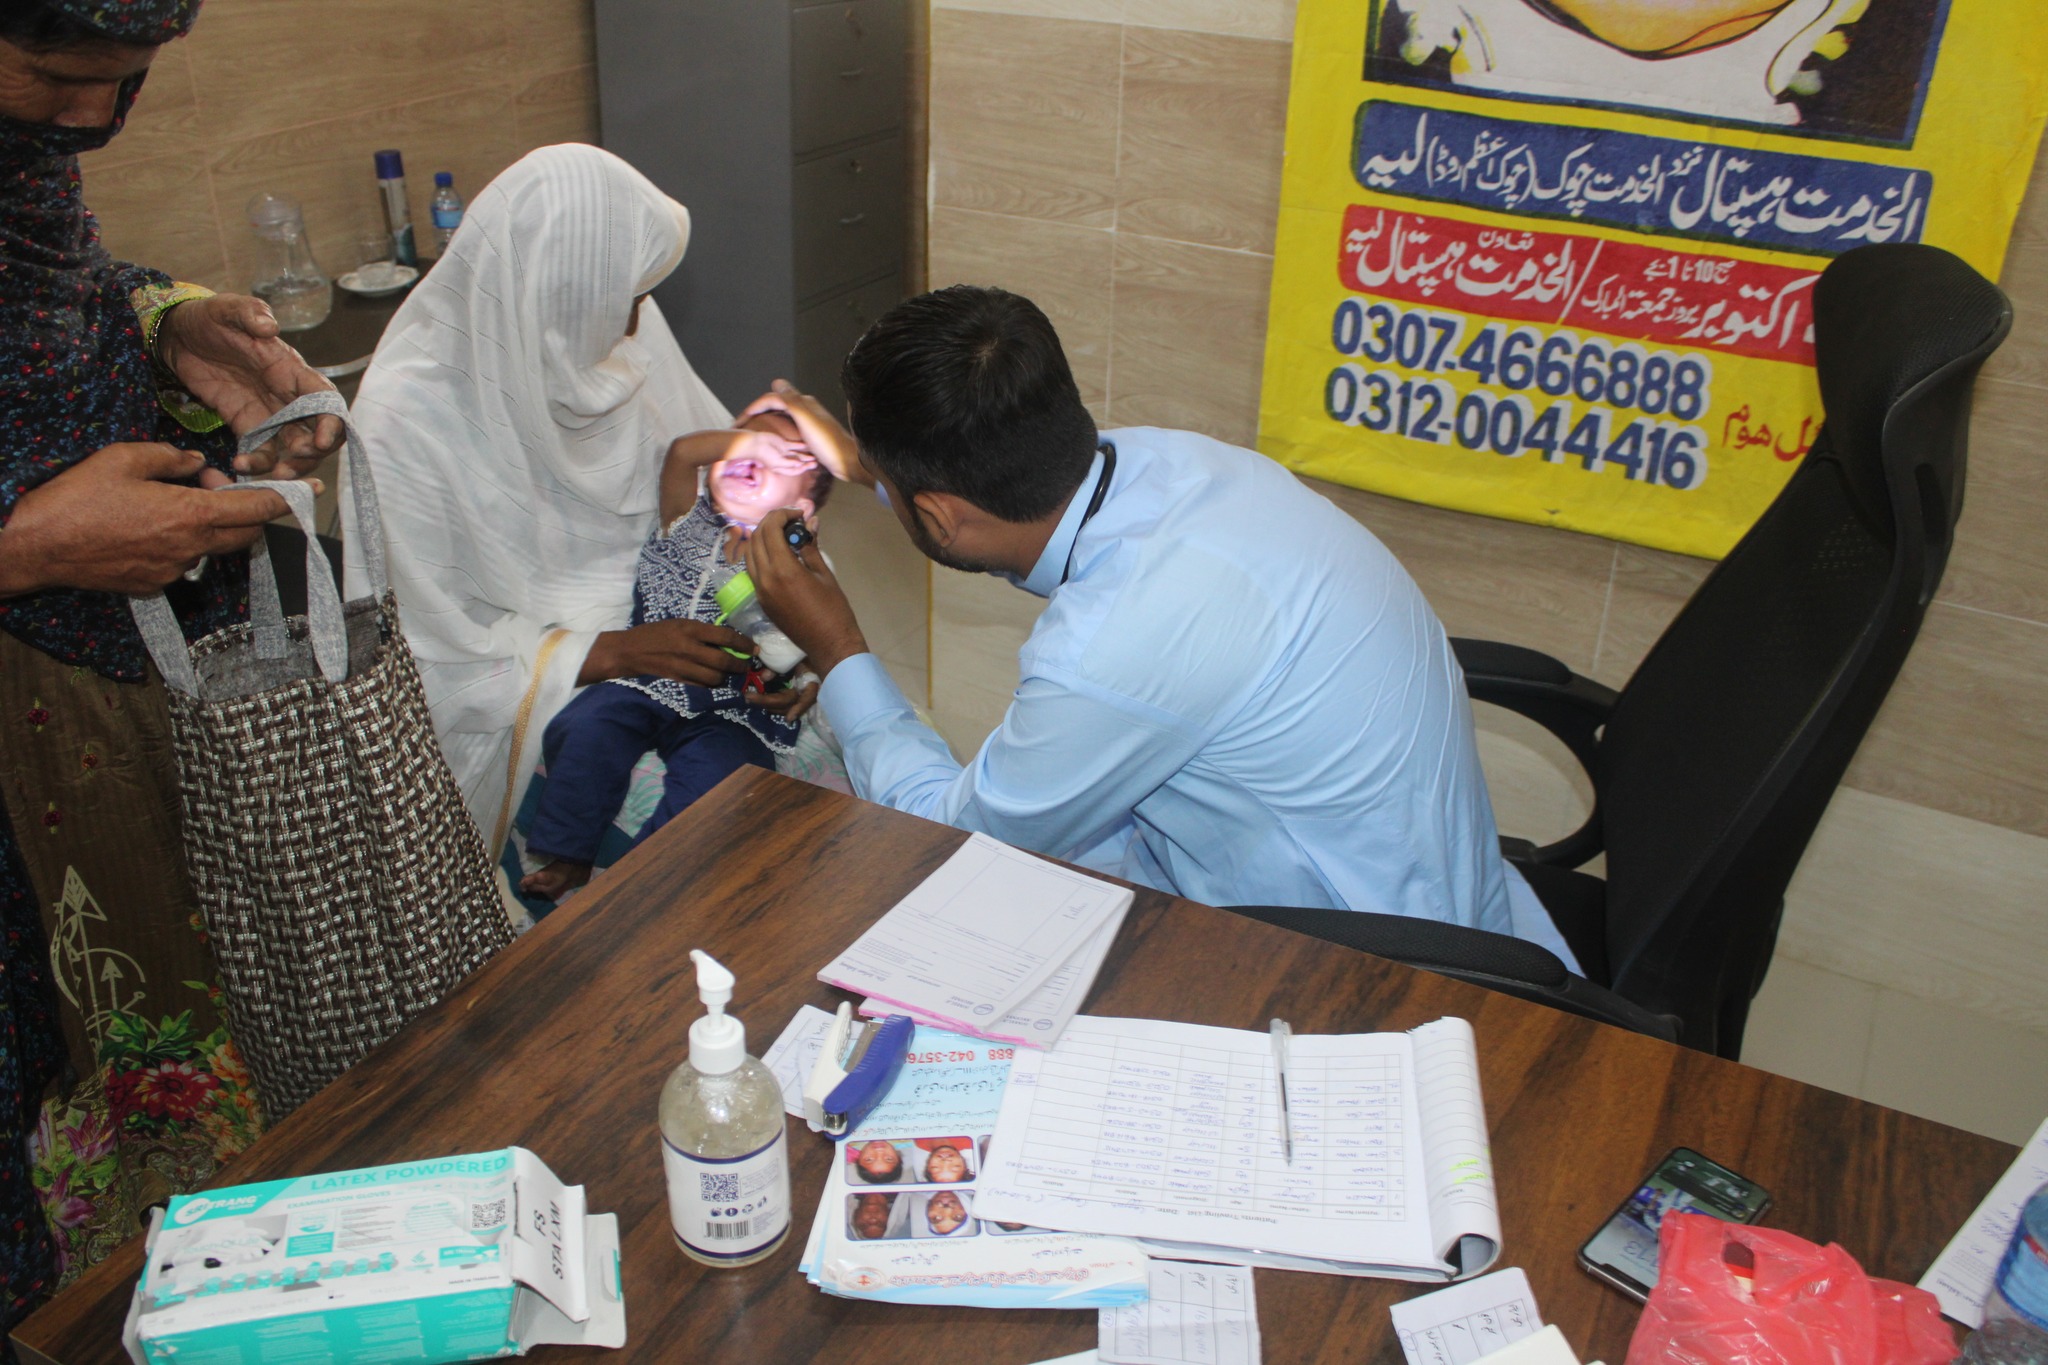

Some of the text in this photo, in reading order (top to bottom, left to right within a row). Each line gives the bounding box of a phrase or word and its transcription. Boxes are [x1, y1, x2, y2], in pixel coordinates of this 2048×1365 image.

[1362, 112, 1428, 188] لیہ
[1667, 145, 1705, 177] نزد
[1532, 143, 1594, 217] چوک
[1582, 154, 1666, 206] الخدمت
[1669, 150, 1794, 238] ہسپتال
[1346, 209, 1384, 253] لیہ
[1775, 172, 1922, 243] الخدمت
[1357, 215, 1468, 297] ہسپتال
[1455, 238, 1576, 303] الخدمت
[1667, 255, 1679, 279] 1
[1694, 259, 1713, 283] 10
[1680, 273, 1822, 350] اکتوبر
[1324, 365, 1701, 490] 0312-0044416
[904, 1050, 976, 1064] 042-3576
[310, 1171, 377, 1191] LATEX
[385, 1156, 508, 1181] POWDERED
[533, 1209, 548, 1237] FS
[552, 1243, 564, 1280] STA
